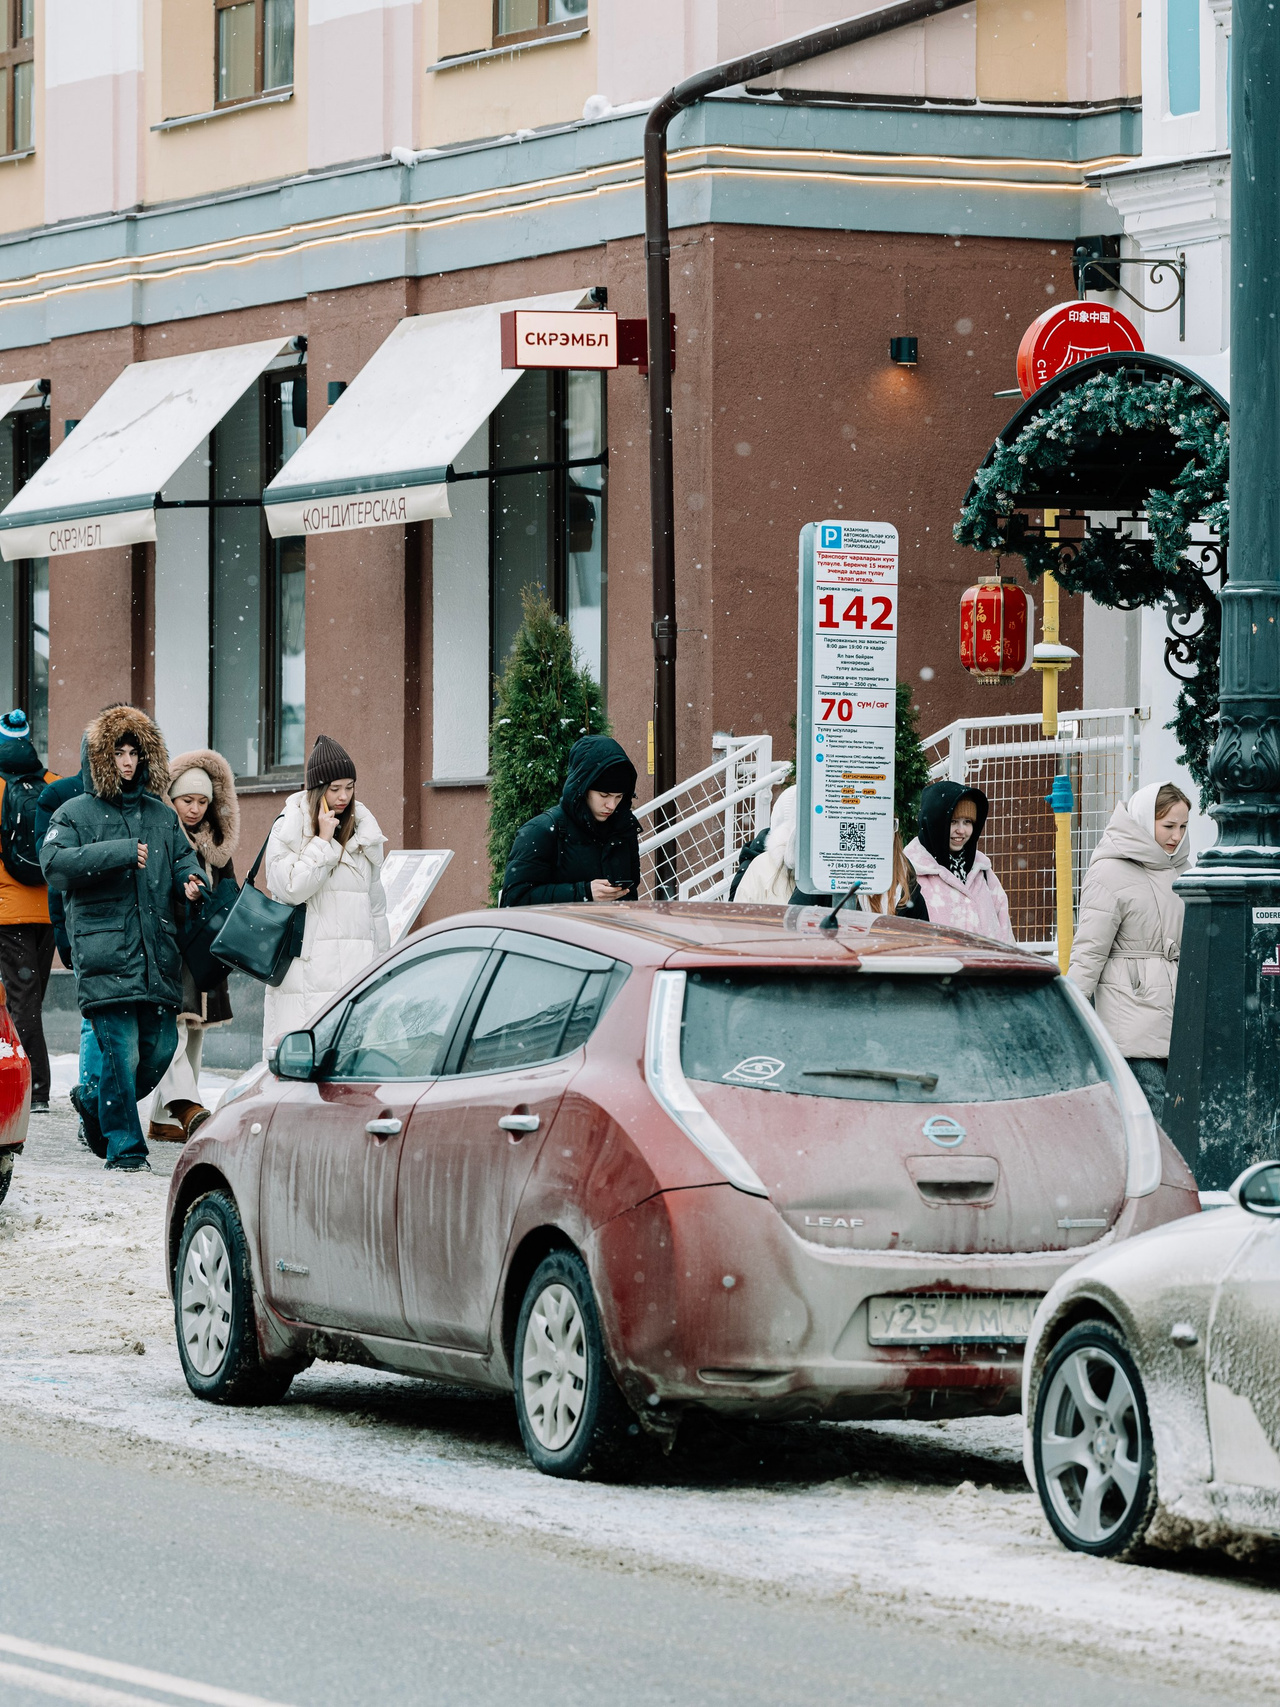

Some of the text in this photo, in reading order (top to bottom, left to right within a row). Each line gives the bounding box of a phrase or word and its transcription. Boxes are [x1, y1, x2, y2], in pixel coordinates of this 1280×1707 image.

[1069, 310, 1110, 324] 印象中国
[525, 332, 608, 346] СКРЭМБЛ
[303, 497, 407, 531] КОНДИТЕРСКАЯ
[48, 524, 102, 552] СКРЭМБЛ
[818, 594, 893, 630] 142
[821, 698, 853, 721] 70
[804, 1216, 864, 1228] LEAF
[881, 1303, 1000, 1334] У254УМ
